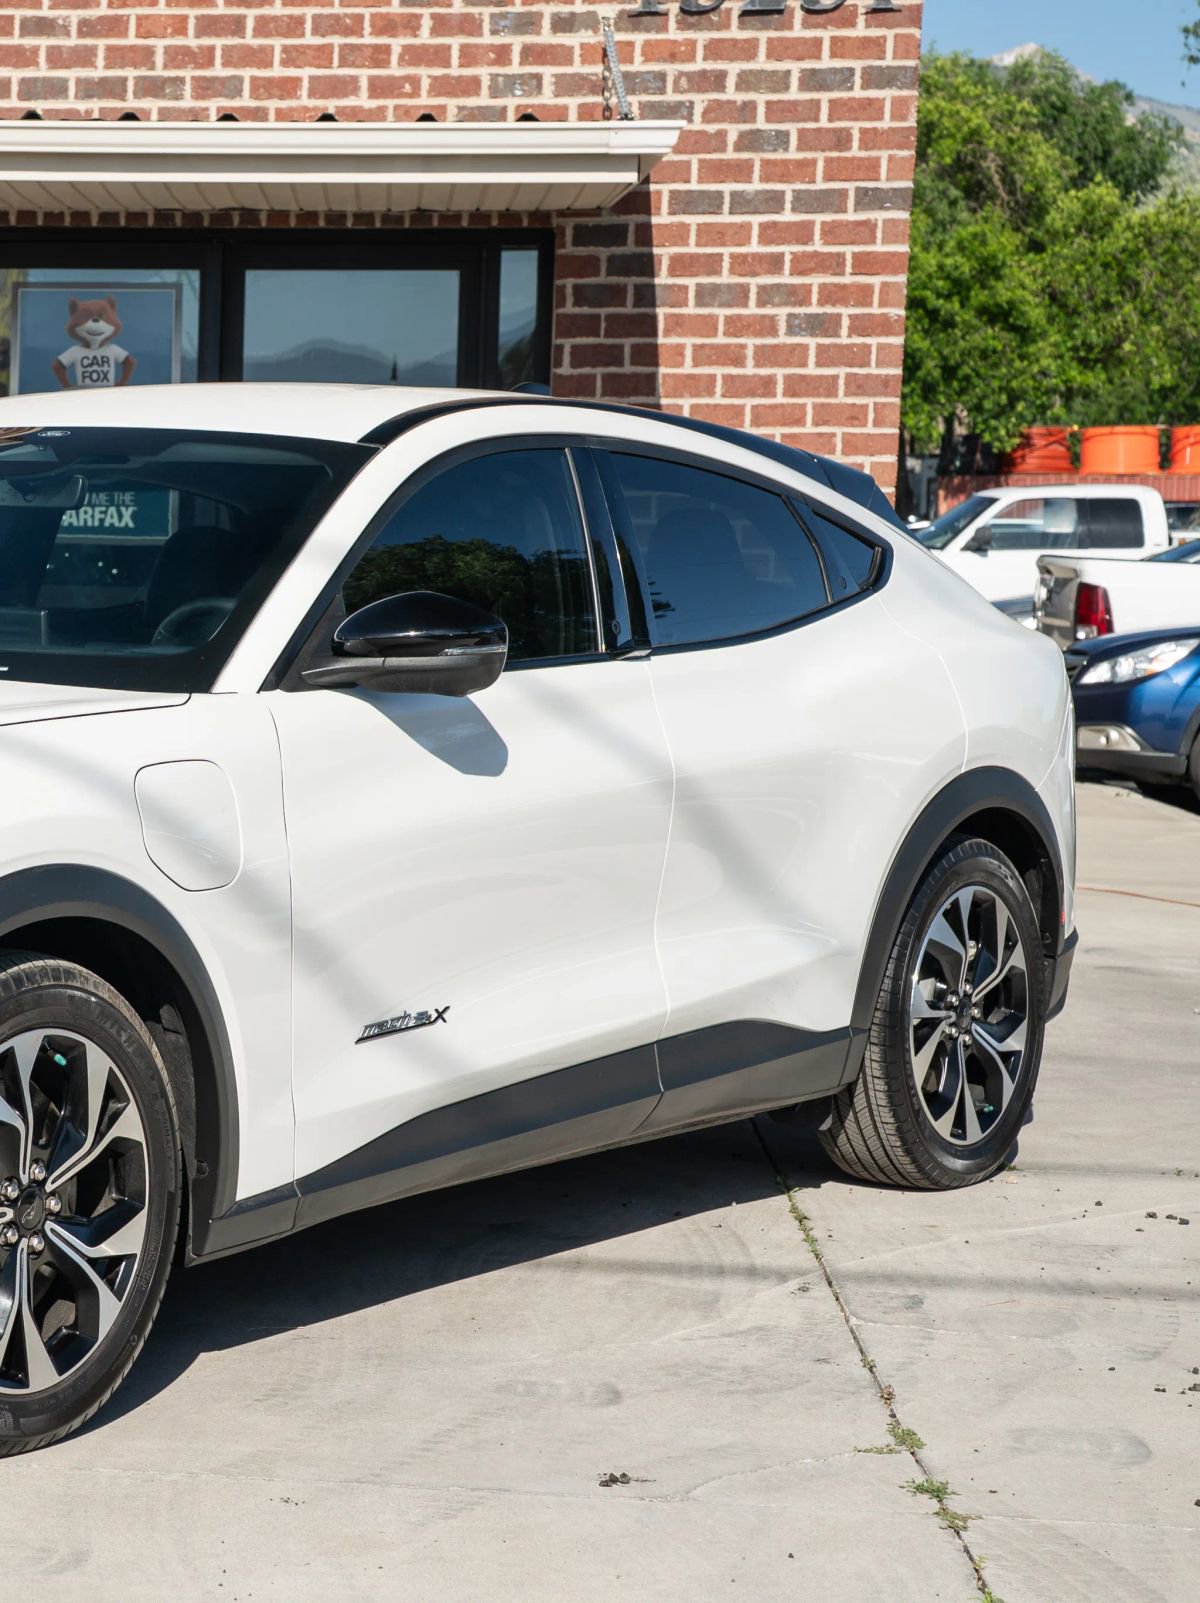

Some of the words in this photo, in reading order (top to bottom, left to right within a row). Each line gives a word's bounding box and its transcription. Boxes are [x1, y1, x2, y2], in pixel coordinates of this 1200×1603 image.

[80, 355, 111, 369] CAR
[81, 370, 110, 384] FOX
[91, 491, 110, 506] ME
[112, 491, 135, 506] THE
[62, 506, 136, 529] ARFAX
